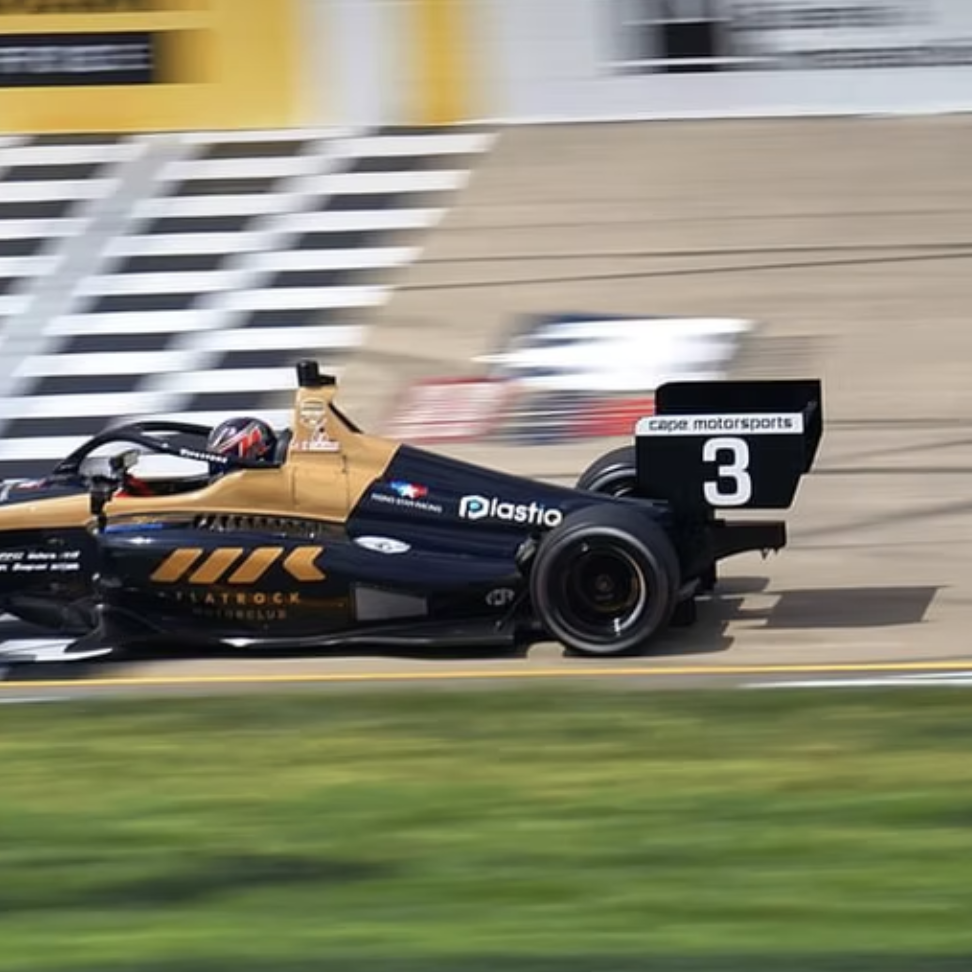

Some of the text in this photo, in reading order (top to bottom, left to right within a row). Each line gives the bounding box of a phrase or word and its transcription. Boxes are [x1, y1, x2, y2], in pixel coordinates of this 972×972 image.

[649, 416, 793, 432] cape motorsports
[702, 436, 752, 506] 3
